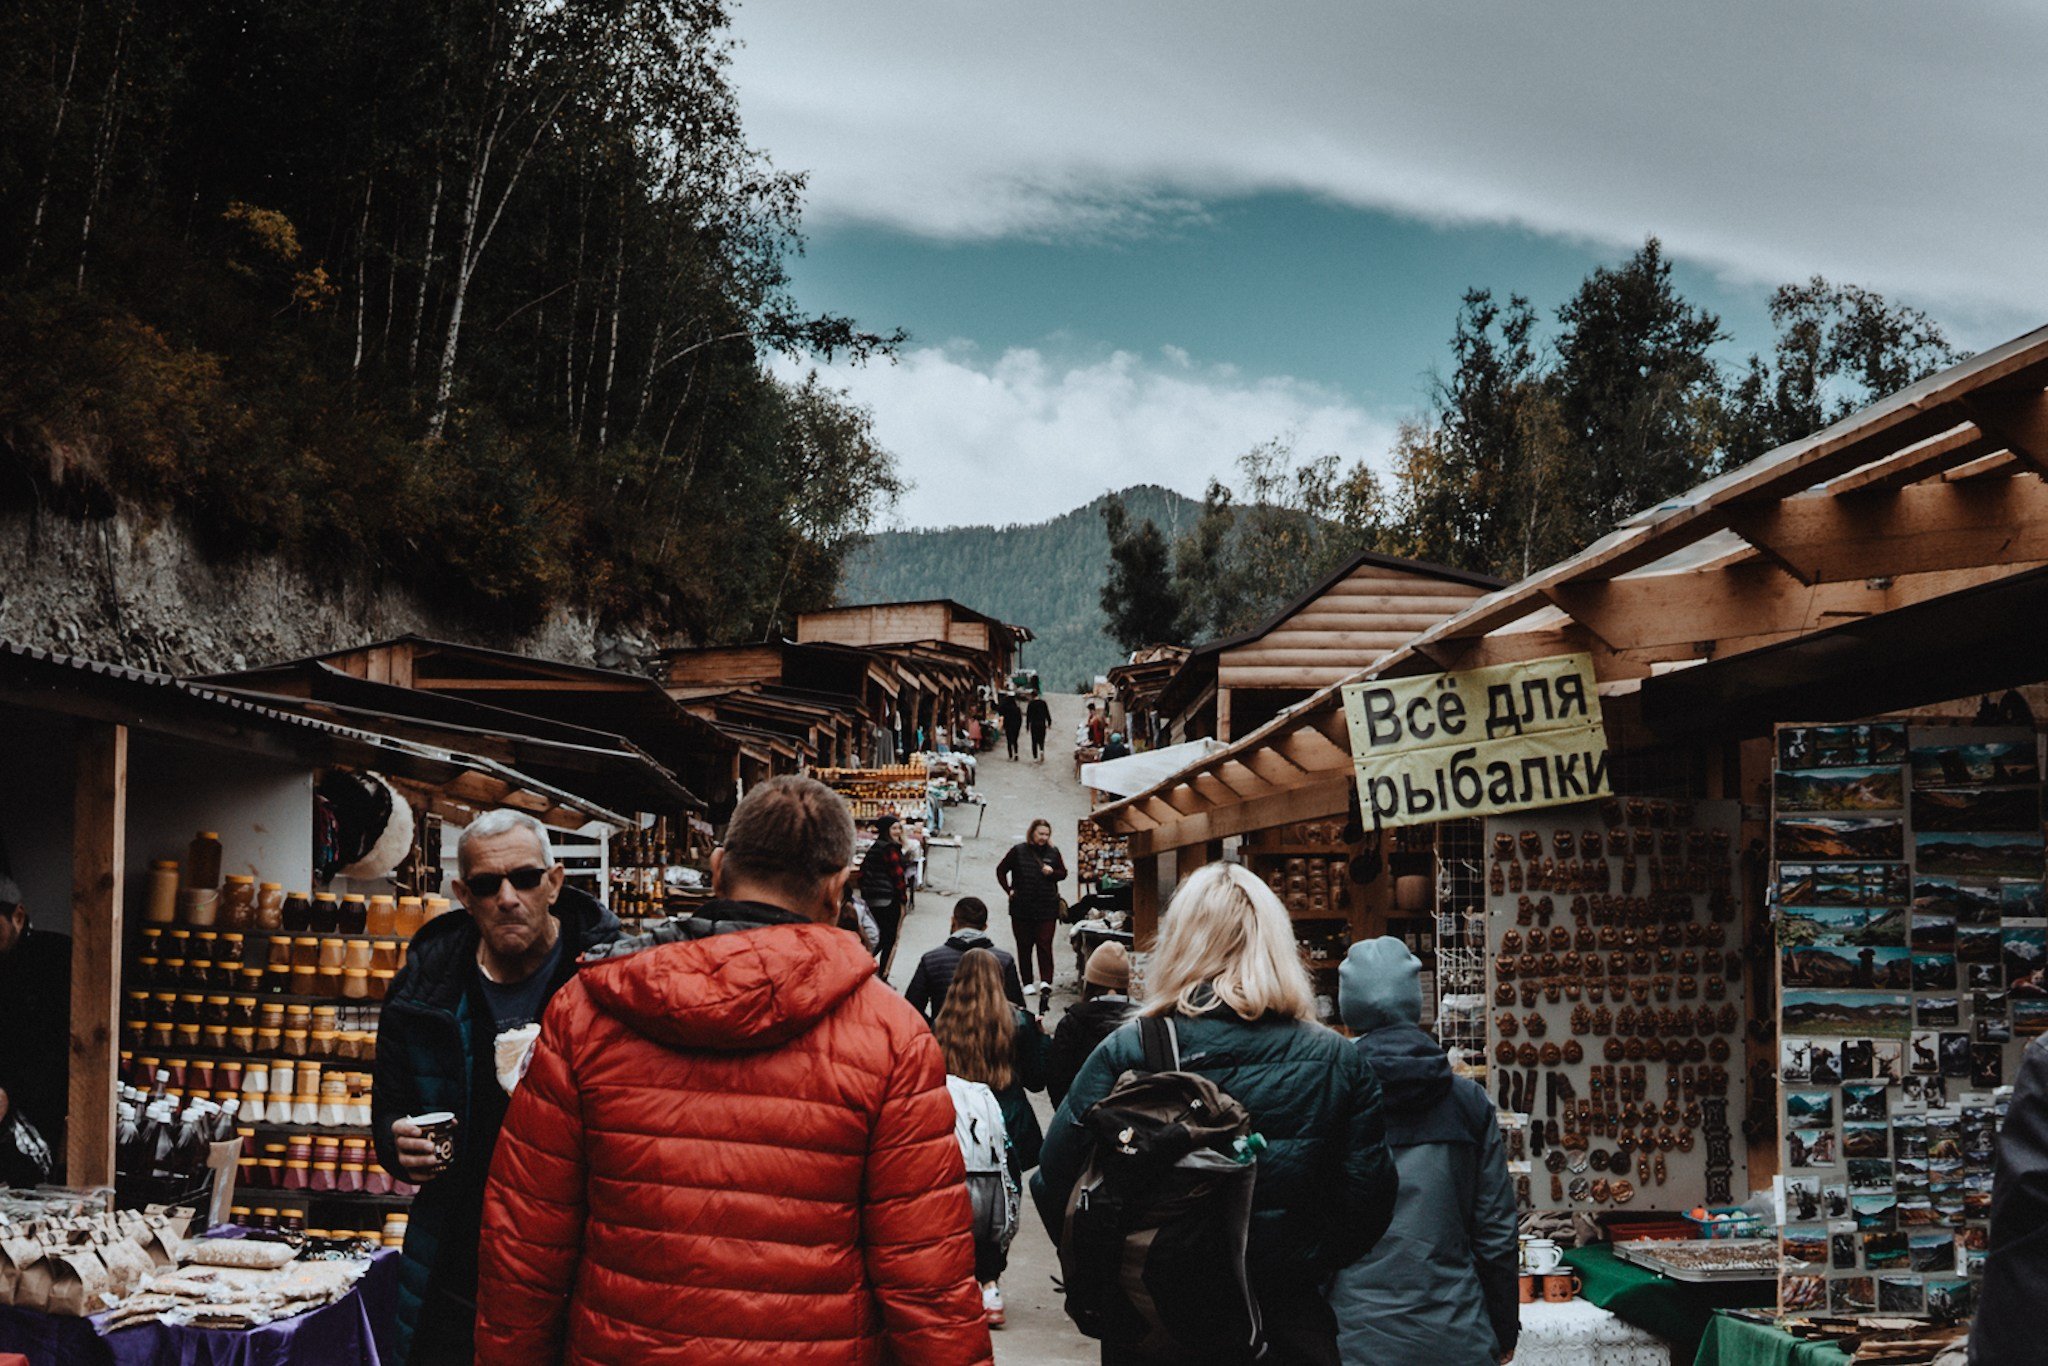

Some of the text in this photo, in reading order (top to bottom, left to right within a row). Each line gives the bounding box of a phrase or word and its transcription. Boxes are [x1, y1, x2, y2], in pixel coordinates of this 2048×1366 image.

[1362, 673, 1588, 747] Всё для
[1367, 748, 1613, 830] рыбалки
